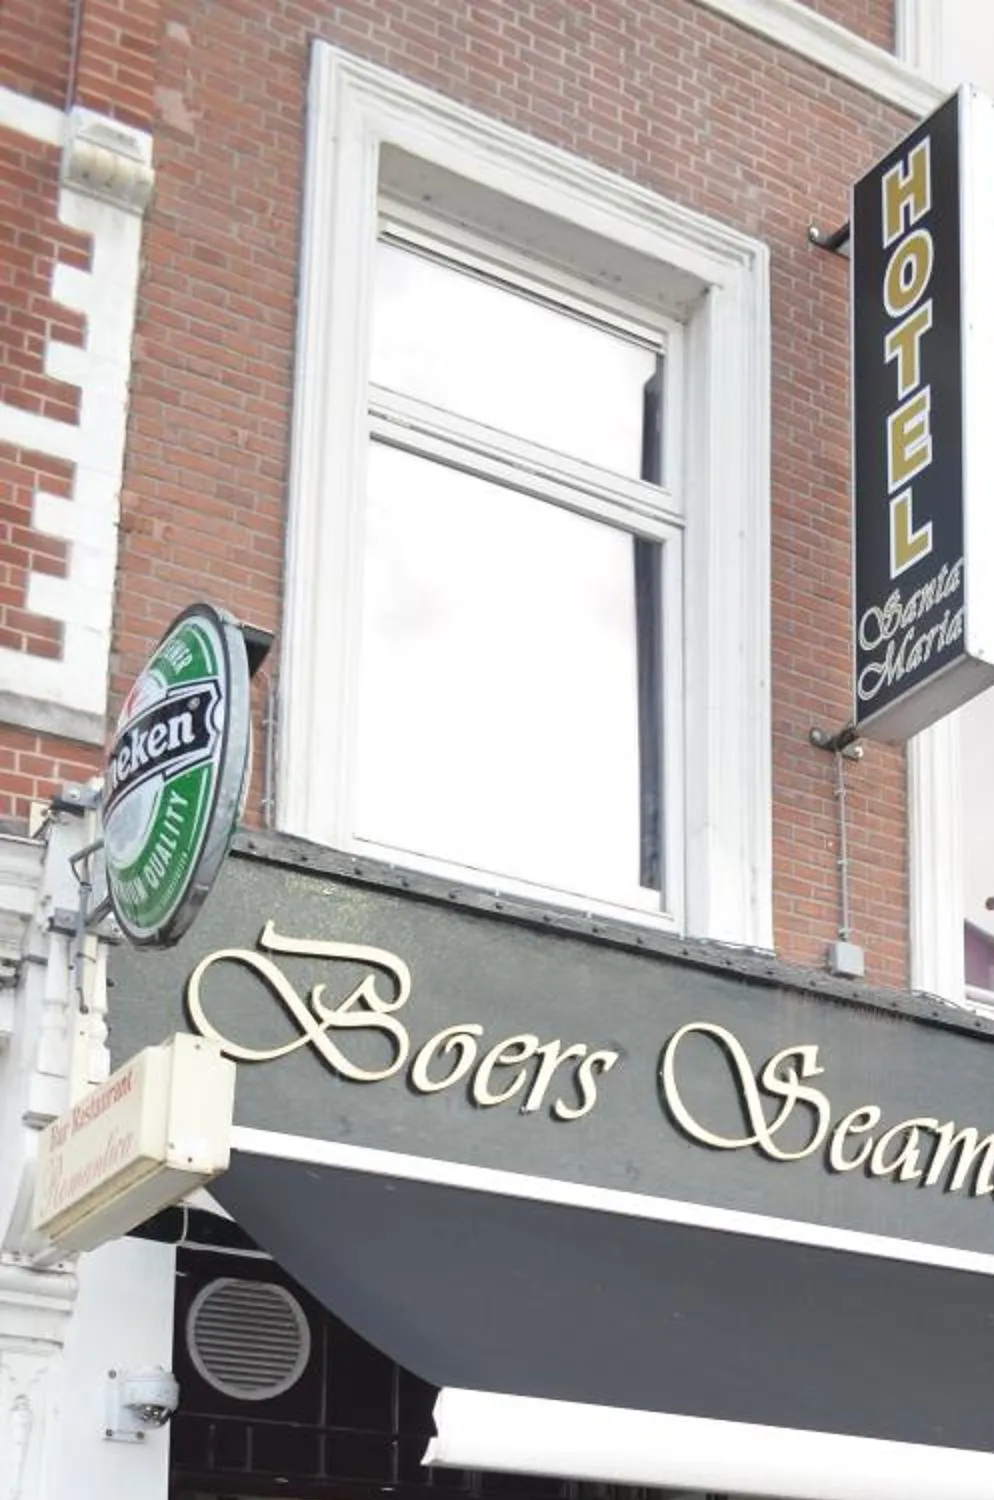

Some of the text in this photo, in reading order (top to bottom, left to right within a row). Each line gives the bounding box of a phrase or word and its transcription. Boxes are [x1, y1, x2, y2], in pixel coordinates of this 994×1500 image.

[881, 136, 934, 580] HOTEL
[858, 605, 964, 701] Maria
[859, 557, 964, 651] Santa
[142, 789, 190, 891] QUALITY
[187, 920, 619, 1121] Boers
